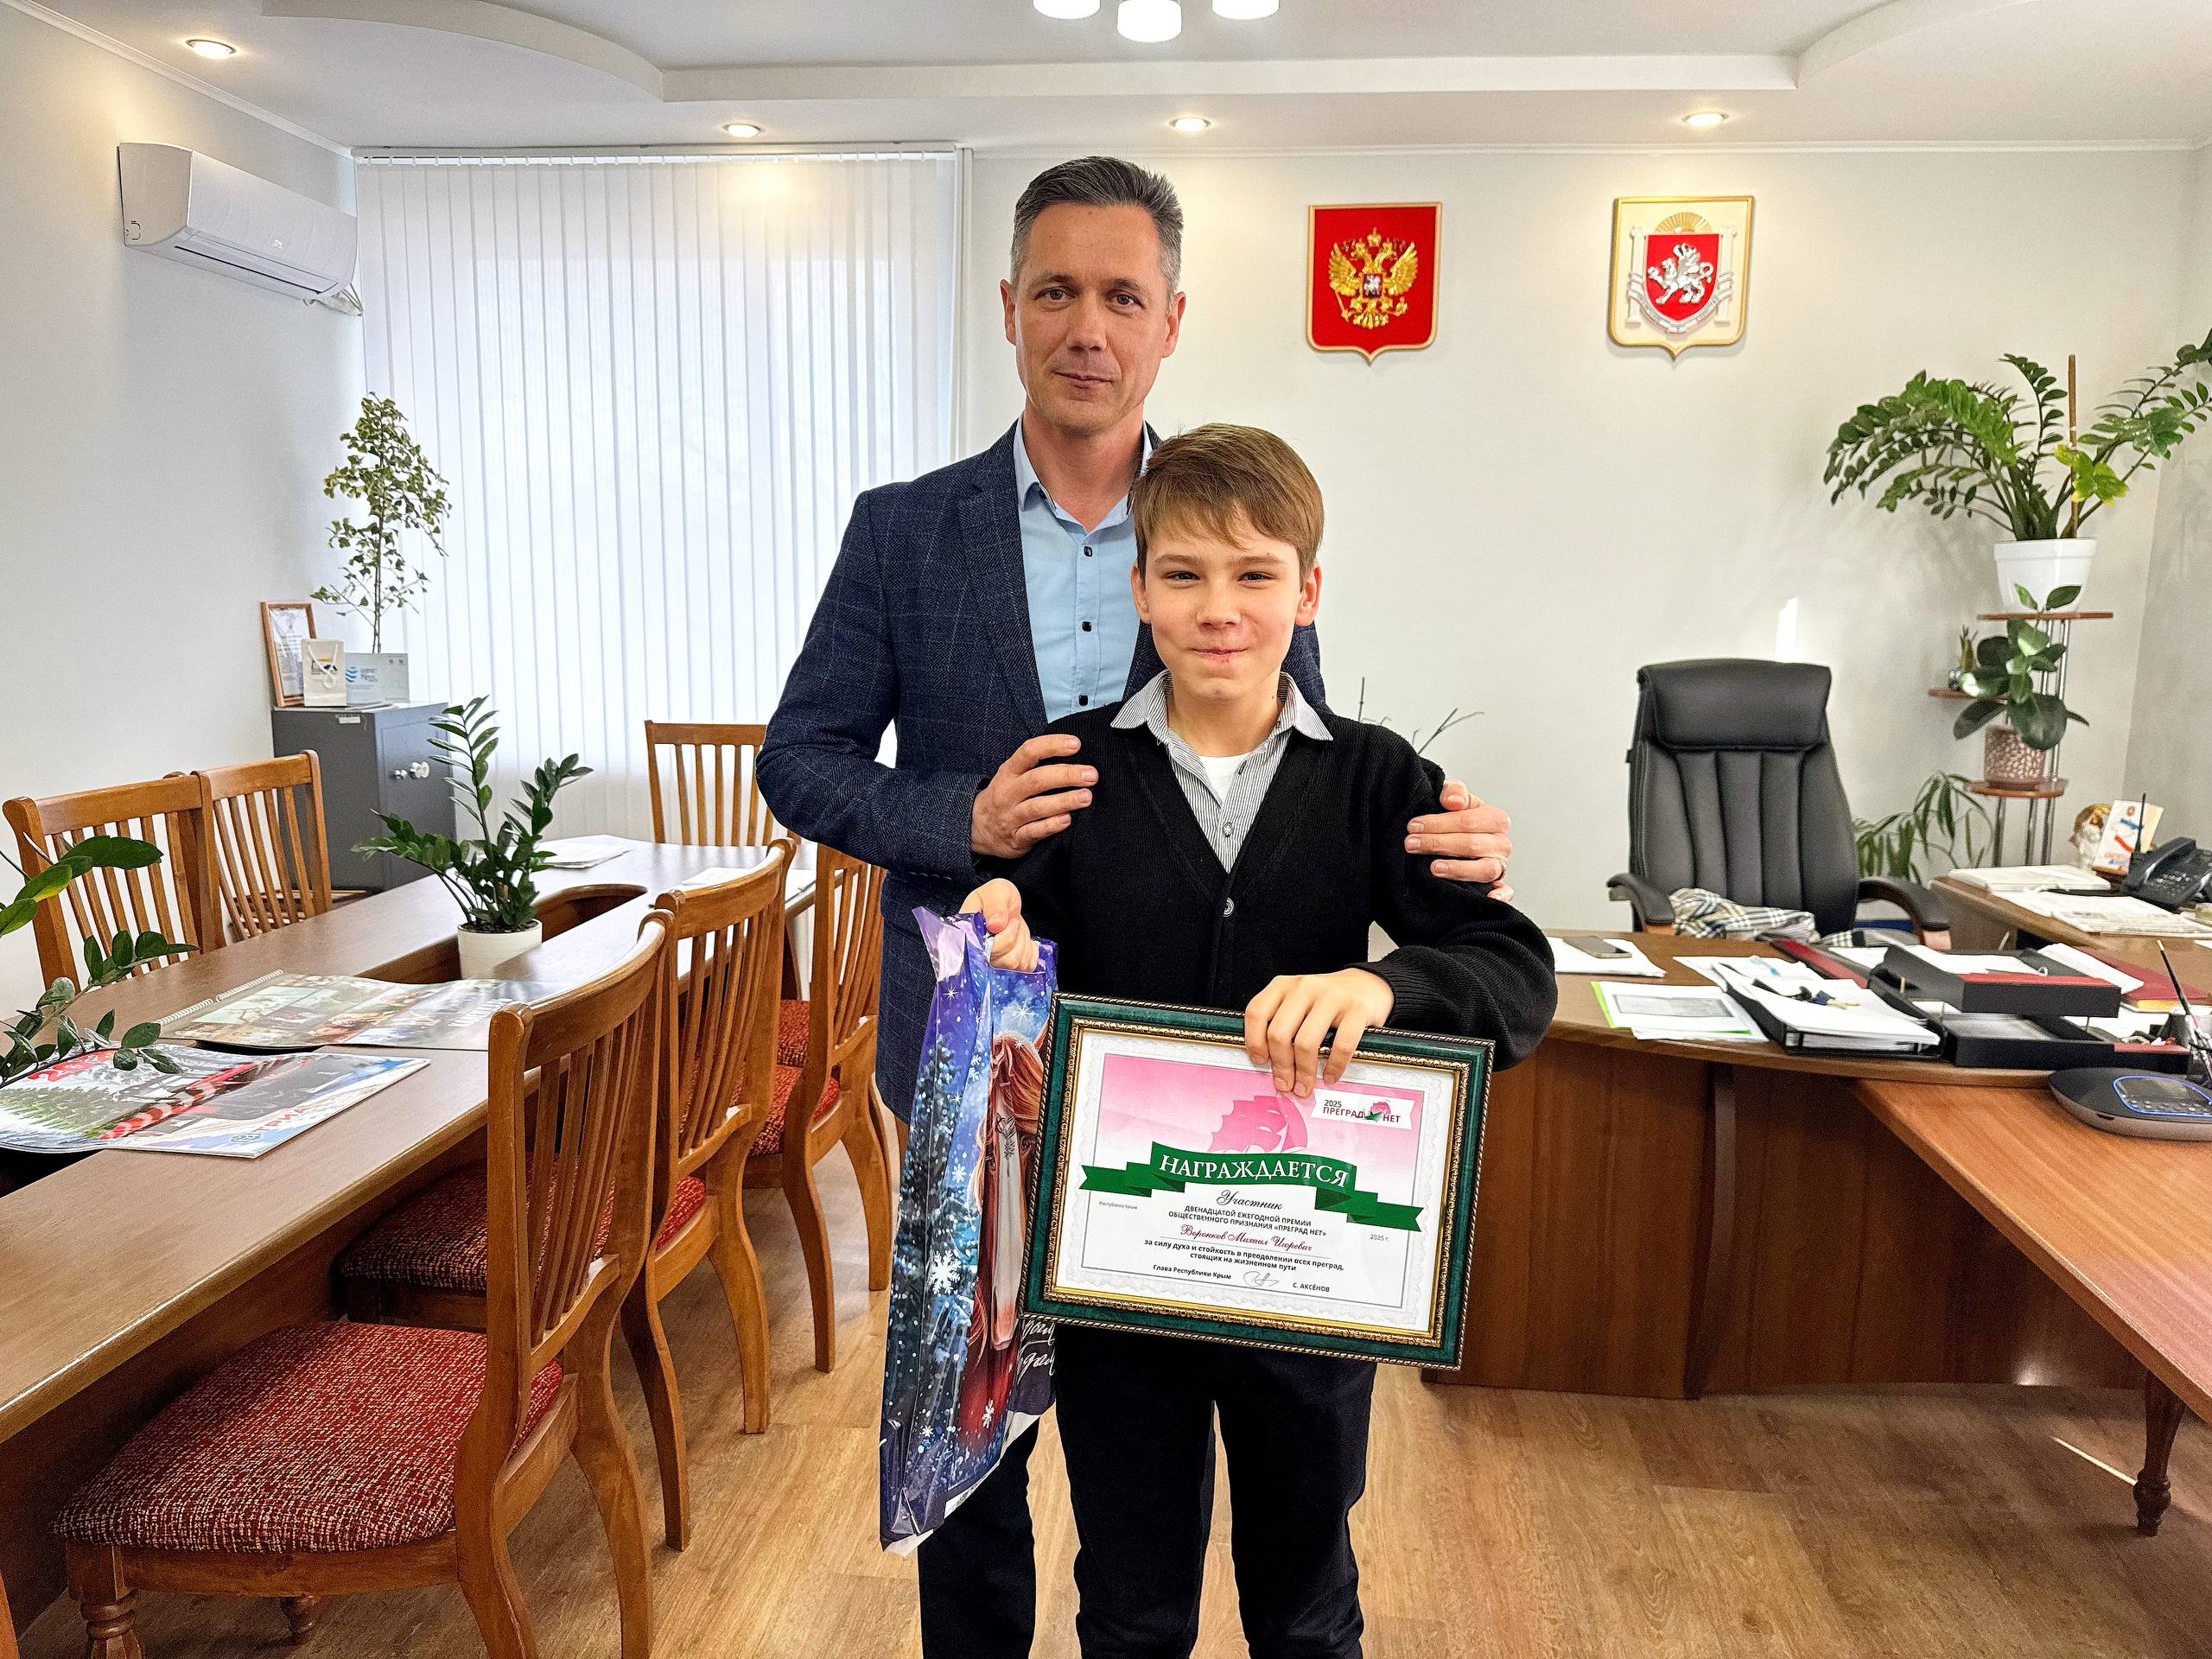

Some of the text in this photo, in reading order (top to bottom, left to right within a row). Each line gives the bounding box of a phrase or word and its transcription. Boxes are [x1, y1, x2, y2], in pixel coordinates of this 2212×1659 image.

[1324, 1099, 1342, 1108] 2025
[1323, 1106, 1401, 1123] ПРЕГРАД НЕТ
[1159, 1154, 1351, 1188] НАГРАЖДАЕТСЯ
[1216, 1189, 1283, 1211] Участник
[1168, 1211, 1327, 1236] ОБЩЕСТВЕННОГО ПРИЗНАНИЯ «ПРЕГРАД НЕТ»
[1184, 1205, 1312, 1226] ДВЕНАДЦАТОЙ ЕЖЕГОДНОЙ ПРЕМИИ
[1180, 1224, 1313, 1252] Воронков Михаил Игоревич
[1370, 1233, 1384, 1242] 2025
[1173, 1243, 1191, 1251] духа
[1198, 1245, 1236, 1256] стойкость
[1243, 1251, 1294, 1264] преодолении
[1294, 1258, 1312, 1267] всех
[1312, 1261, 1344, 1271] преград,
[1190, 1253, 1223, 1262] стоящих
[1234, 1258, 1277, 1268] жизненном
[1153, 1264, 1231, 1280] Глава Республики Крым
[1300, 1283, 1330, 1292] АКСЁНОВ
